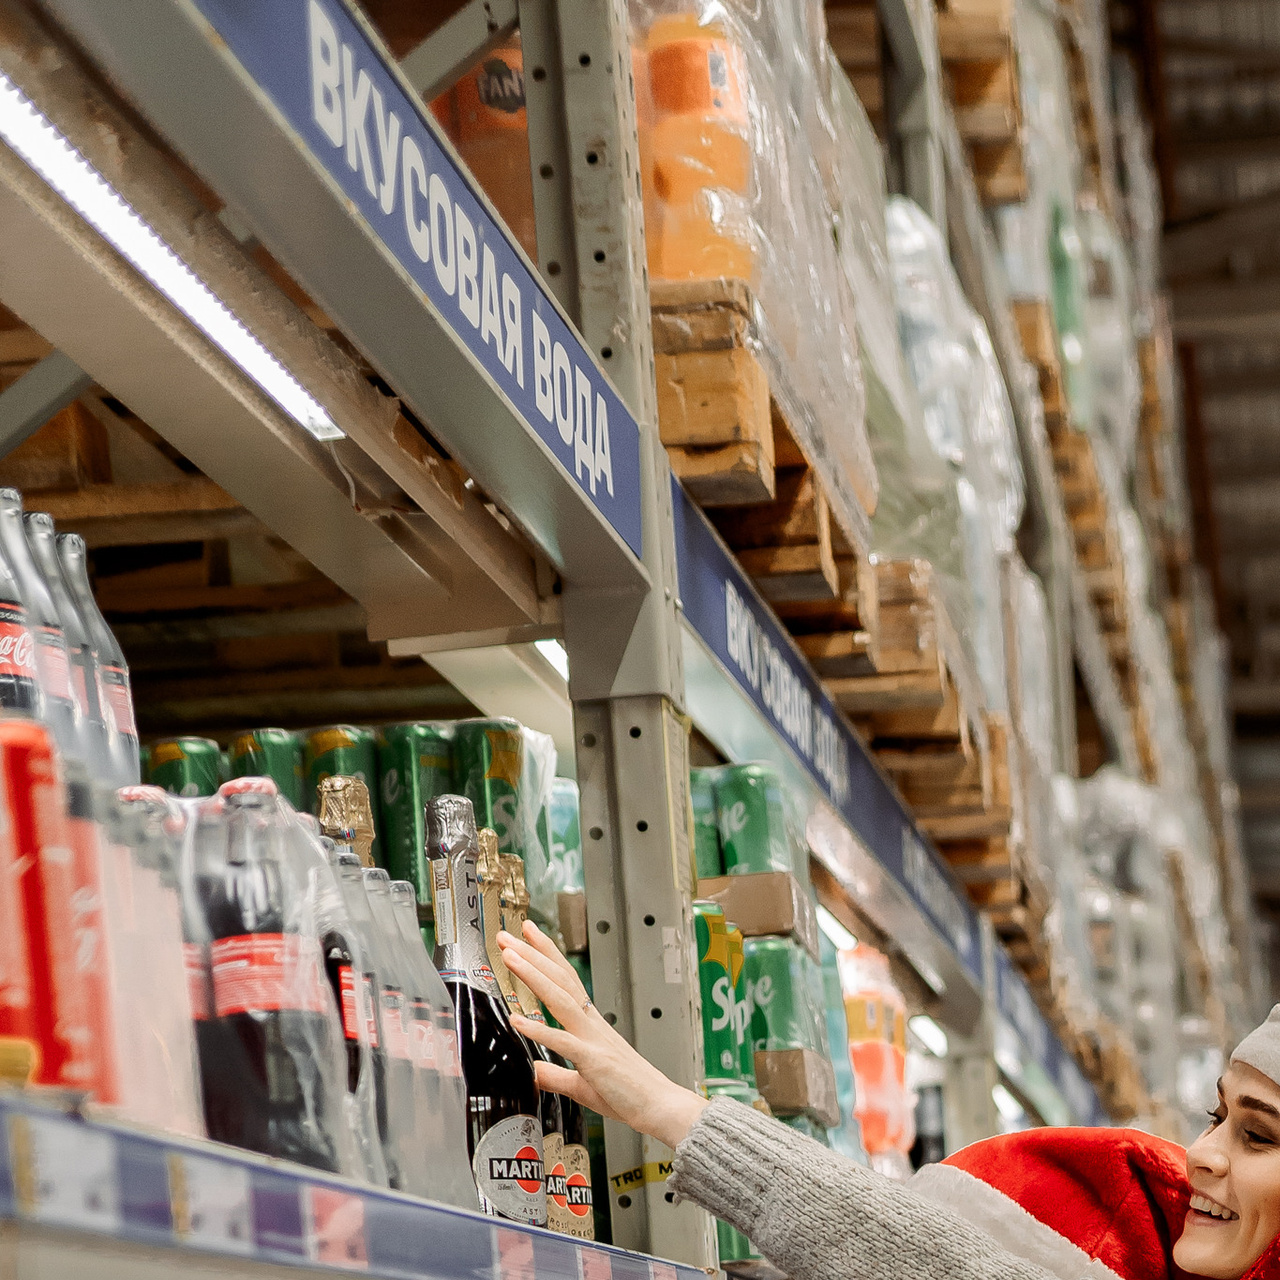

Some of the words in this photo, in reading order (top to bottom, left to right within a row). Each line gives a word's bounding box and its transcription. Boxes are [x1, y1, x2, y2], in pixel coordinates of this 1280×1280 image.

[308, 0, 525, 391] ВКУСОВАЯ
[532, 308, 615, 499] ВОДА
[464, 858, 480, 932] ASTI
